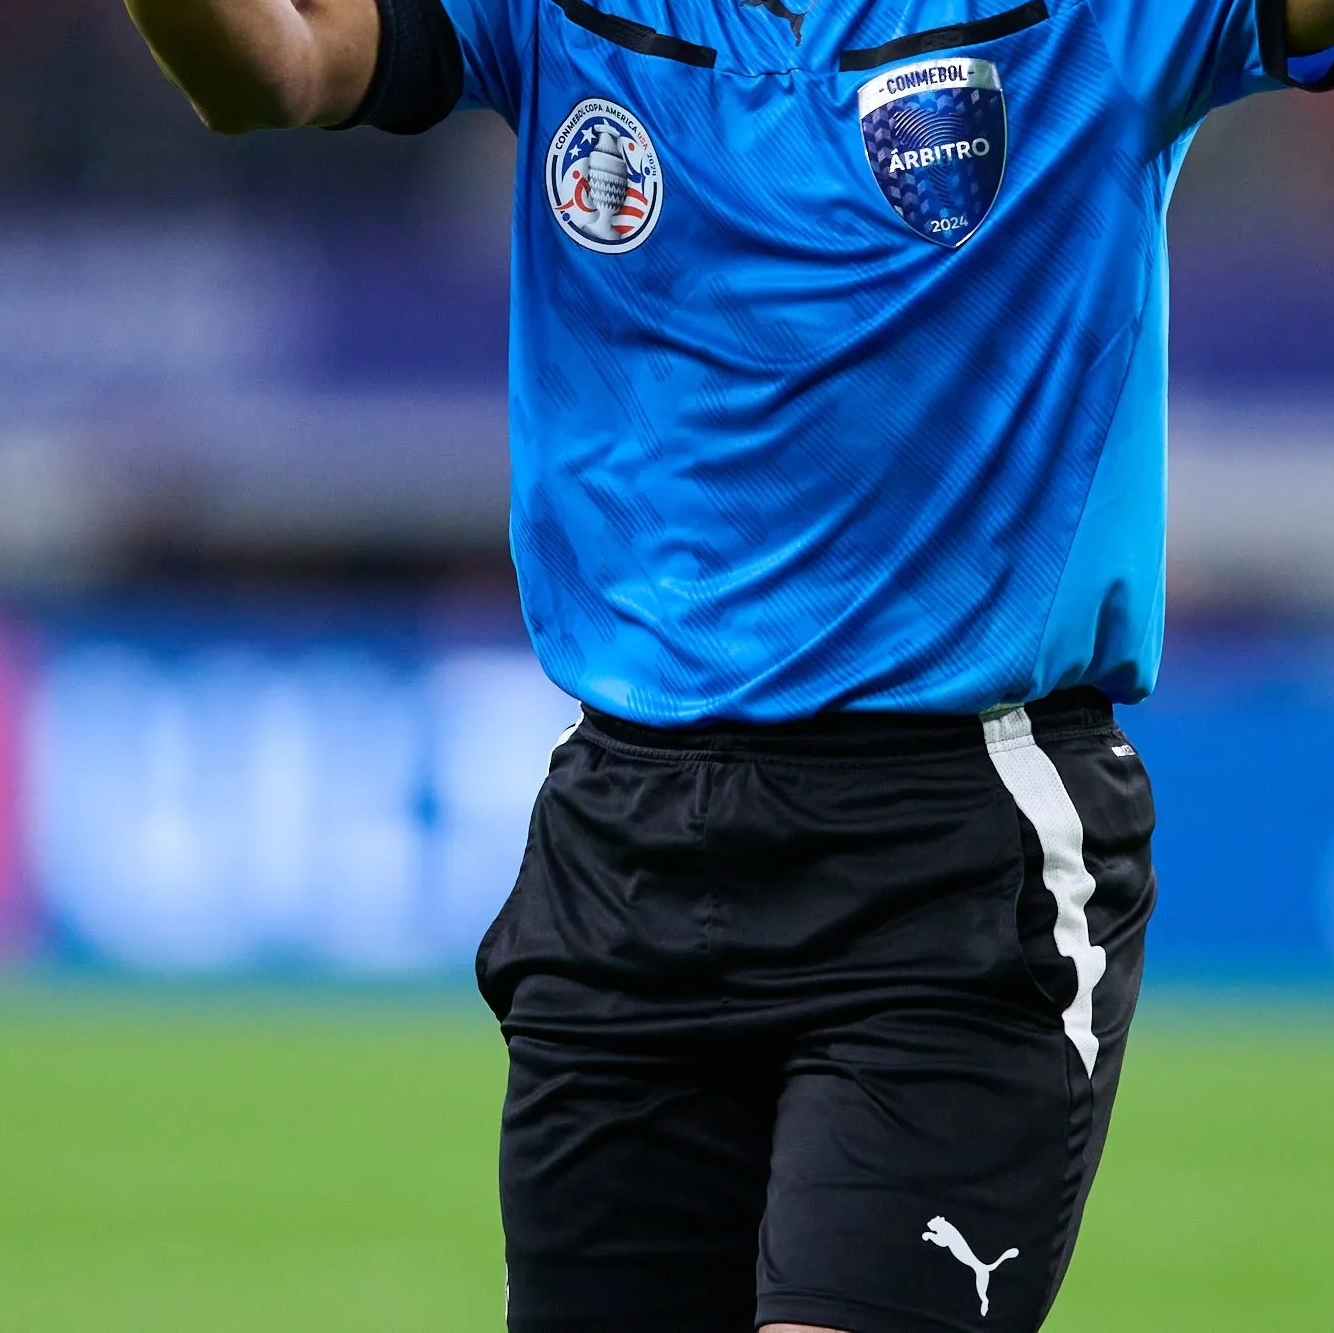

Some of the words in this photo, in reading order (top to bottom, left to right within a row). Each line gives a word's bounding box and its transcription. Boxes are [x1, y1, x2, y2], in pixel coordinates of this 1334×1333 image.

[555, 107, 586, 150] CONMEBOL
[584, 103, 603, 113] COPA
[605, 105, 638, 133] AMERICA
[637, 132, 648, 151] USA
[647, 152, 657, 177] 2024
[889, 137, 990, 173] ÁRBITRO
[930, 216, 969, 233] 2024
